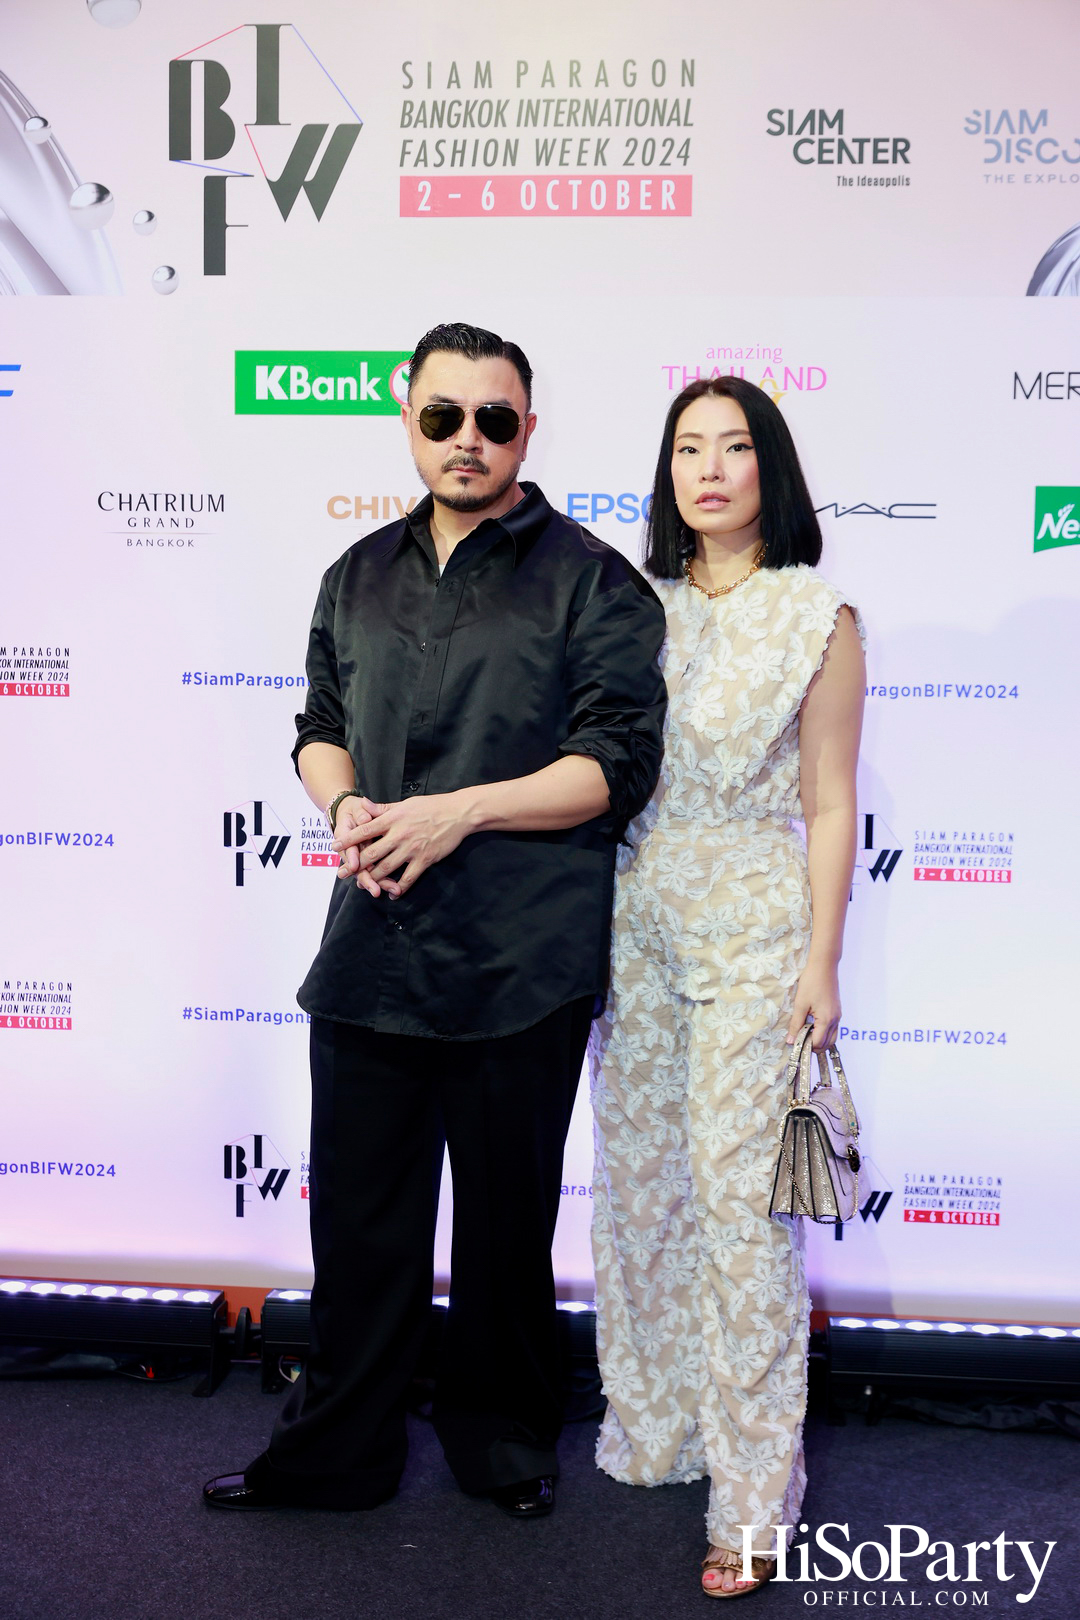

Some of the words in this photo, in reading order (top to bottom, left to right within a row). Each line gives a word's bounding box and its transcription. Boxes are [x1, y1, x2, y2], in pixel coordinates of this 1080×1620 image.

[401, 60, 493, 90] SIAM
[516, 58, 696, 89] PARAGON
[400, 98, 511, 129] BANGKOK
[516, 98, 695, 128] INTERNATIONAL
[766, 108, 844, 137] SIAM
[963, 108, 1049, 136] SIAM
[399, 138, 520, 168] FASHION
[535, 137, 611, 167] WEEK
[622, 137, 692, 167] 2024
[792, 137, 911, 165] CENTER
[836, 175, 854, 188] The
[856, 175, 911, 189] Ideaopolis
[983, 173, 1016, 184] THE
[417, 180, 432, 212] 2
[481, 179, 495, 211] 6
[520, 178, 676, 211] OCTOBER
[705, 343, 783, 364] amazing
[255, 361, 383, 402] KBank
[97, 490, 226, 513] CHATRIUM
[127, 516, 195, 529] GRAND
[126, 538, 195, 548] BANGKOK
[13, 646, 70, 657] PARAGON
[13, 659, 70, 669] INTERNATIONAL
[19, 671, 44, 682] WEEK
[47, 671, 69, 682] 2024
[182, 671, 311, 690] #SiamParagon
[3, 683, 9, 695] 6
[15, 683, 66, 696] OCTOBER
[301, 816, 328, 827] SIA
[301, 829, 334, 840] BANGKO
[914, 830, 946, 841] SIAM
[953, 831, 1014, 842] PARAGON
[914, 843, 951, 853] BANGKOK
[953, 844, 1013, 855] INTERNATIONAL
[306, 854, 313, 866] 2
[327, 855, 333, 866] 6
[913, 855, 954, 866] FASHION
[959, 856, 985, 867] WEEK
[988, 857, 1012, 868] 2024
[918, 868, 926, 880] 2
[940, 868, 947, 880] 6
[953, 869, 1009, 882] OCTOBER
[17, 980, 72, 992] PARAGON
[17, 992, 71, 1003] INTERNATIONAL
[23, 1004, 47, 1015] WEEK
[50, 1005, 71, 1016] 2024
[6, 1016, 12, 1028] 6
[18, 1016, 69, 1029] OCTOBER
[840, 1026, 1007, 1045] ParagonBIFW2024
[904, 1172, 935, 1183] SIAM
[942, 1174, 1002, 1186] PARAGON
[904, 1185, 940, 1196] BANGKOK
[943, 1187, 1000, 1198] INTERNATIONAL
[903, 1197, 944, 1208] FASHION
[948, 1199, 973, 1210] WEEK
[978, 1200, 1000, 1211] 2024
[908, 1210, 915, 1222] 2
[929, 1211, 936, 1223] 6
[942, 1211, 997, 1225] OCTOBER
